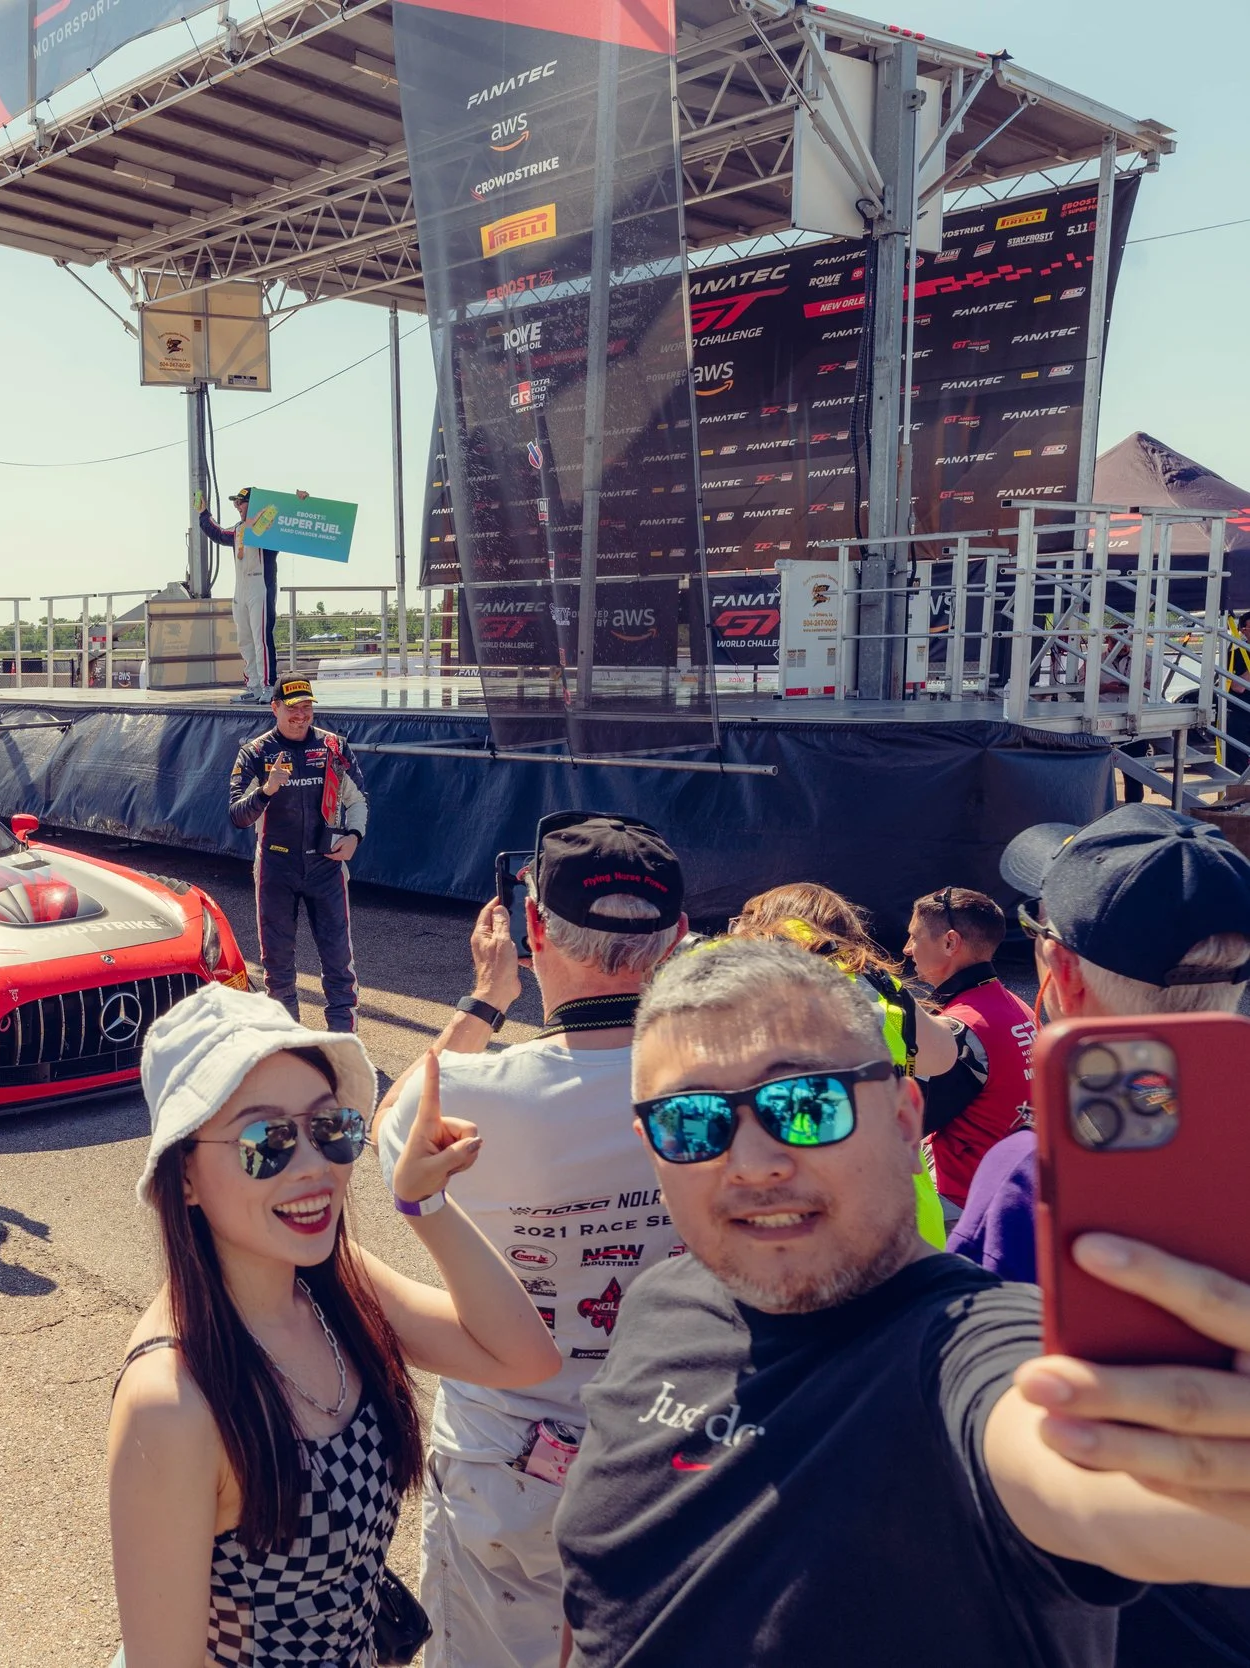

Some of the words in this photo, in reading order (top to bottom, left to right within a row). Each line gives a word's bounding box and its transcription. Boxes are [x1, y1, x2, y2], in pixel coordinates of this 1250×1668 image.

[467, 60, 557, 110] FANATEC
[491, 113, 528, 140] aws
[475, 156, 560, 195] CROWDSTRIKE
[1001, 211, 1042, 227] PIRELLI
[488, 212, 548, 250] PIRELLI
[1067, 223, 1087, 236] 5.11
[689, 264, 791, 296] ANATEC
[808, 274, 842, 287] ROWE
[820, 301, 842, 312] NEW
[952, 300, 1015, 317] FANATEC
[503, 322, 542, 350] ROWE
[699, 327, 764, 346] CHALLENGE
[1012, 327, 1078, 343] FANATEC
[693, 361, 734, 383] aws
[941, 376, 1003, 390] FANATEC
[700, 412, 748, 424] FANATEC
[1002, 406, 1068, 420] FANATEC
[747, 439, 797, 451] FANATEC
[643, 453, 687, 463] FANATEC
[935, 453, 994, 465] FANATEC
[702, 479, 743, 489] ANATEC
[997, 486, 1063, 497] FANATEC
[743, 508, 793, 518] FANATEC
[278, 516, 313, 529] SUPER
[315, 522, 341, 534] FUEL
[640, 517, 685, 526] FANATEC
[474, 602, 546, 613] FANATEC
[712, 594, 781, 607] FANAT
[612, 609, 655, 626] aws
[717, 640, 745, 648] WORLD
[747, 639, 780, 647] CHALLE
[119, 672, 130, 680] aws
[583, 873, 611, 889] Flying
[615, 872, 640, 883] Horse
[644, 875, 669, 894] Power
[531, 1200, 611, 1215] nasa
[514, 1226, 566, 1238] 2021
[580, 1220, 637, 1236] RACE
[646, 1216, 673, 1227] SE
[582, 1244, 644, 1262] NEW
[592, 1302, 619, 1312] NOL
[638, 1381, 708, 1432] Just
